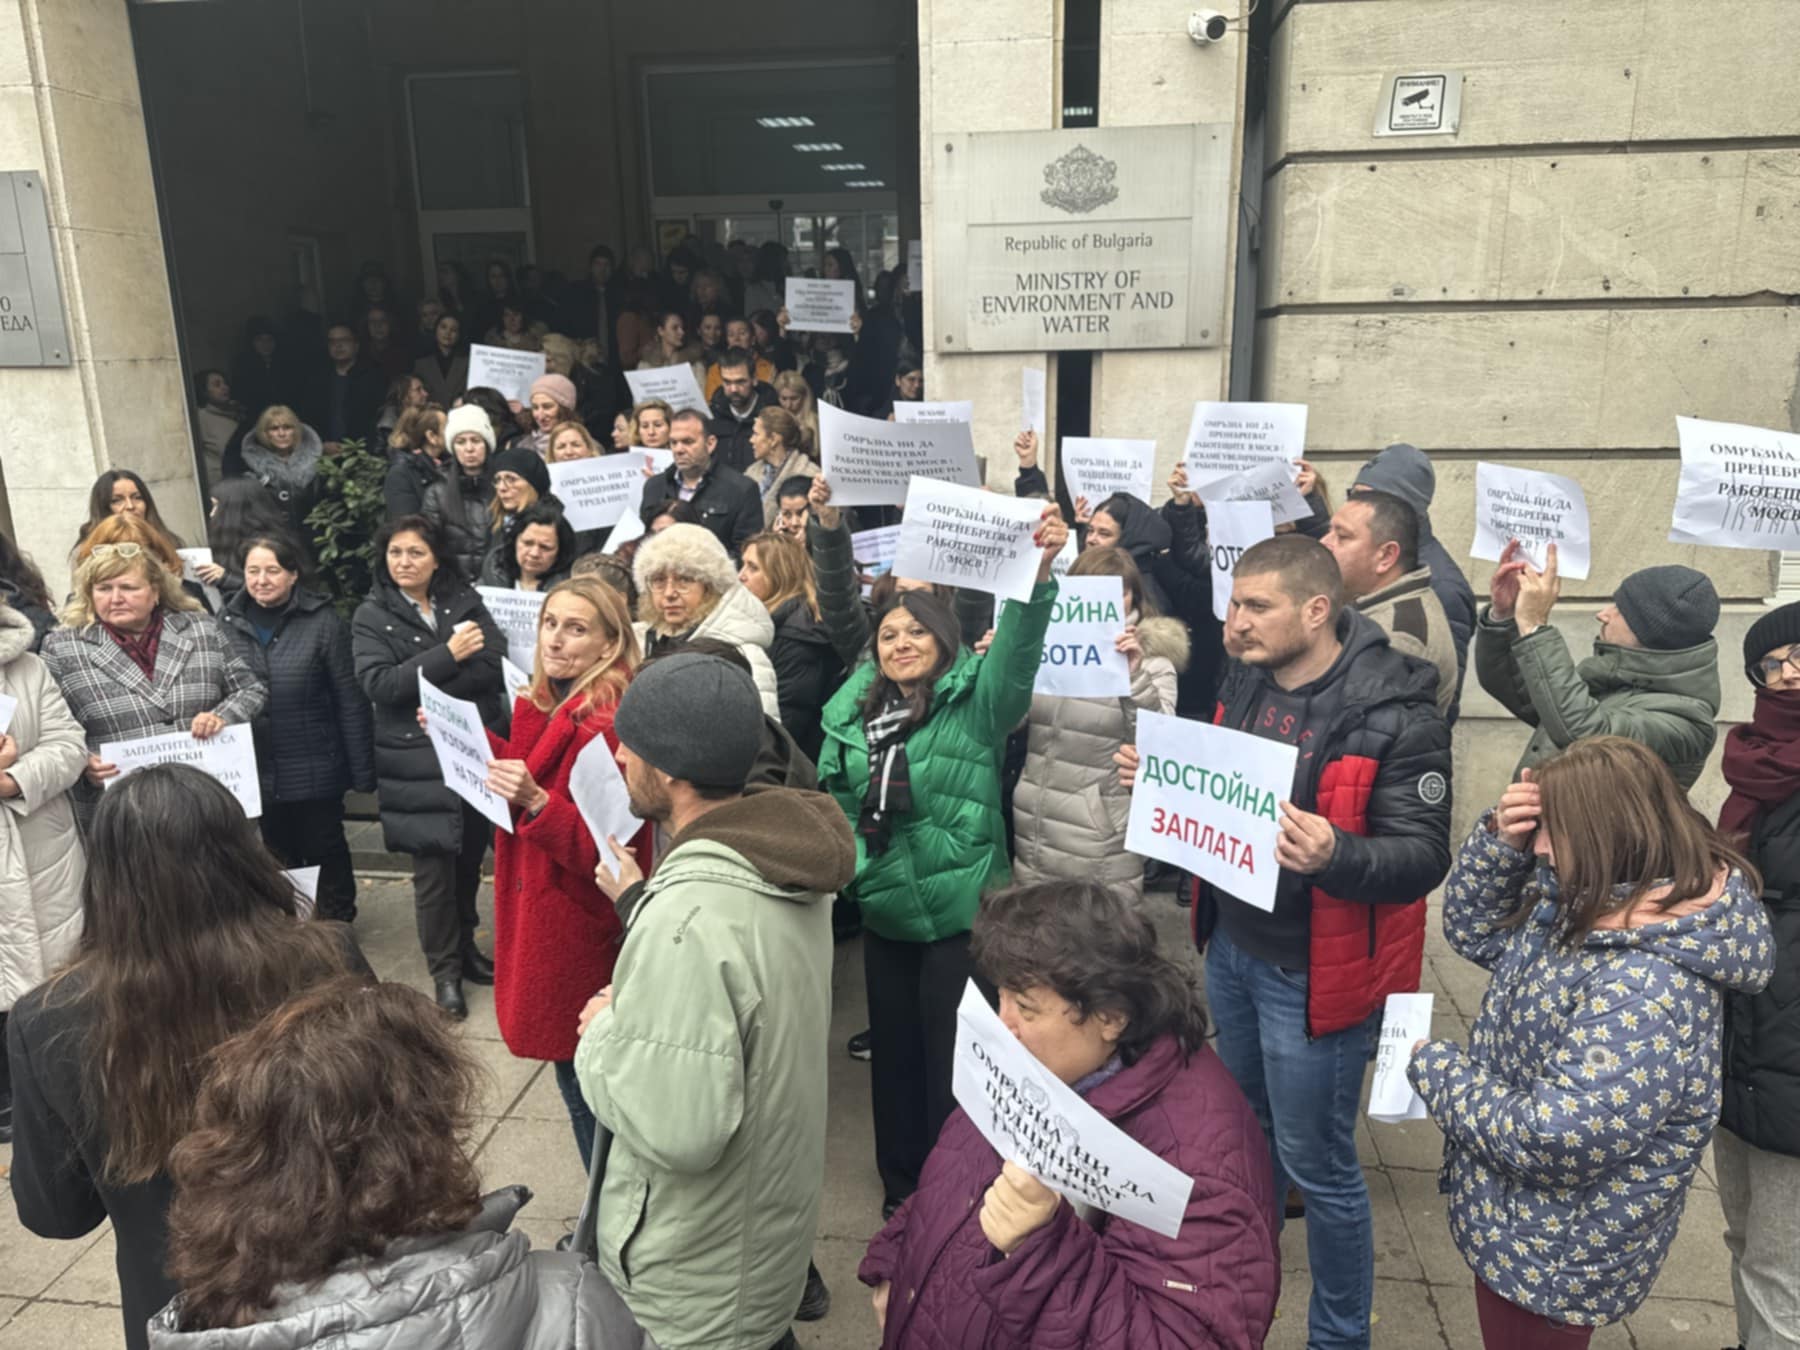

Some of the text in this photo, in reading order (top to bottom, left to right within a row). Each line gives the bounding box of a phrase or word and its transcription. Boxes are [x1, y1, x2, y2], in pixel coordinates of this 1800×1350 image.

[1005, 233, 1153, 254] Republic of Bulgaria
[1016, 269, 1141, 291] MINISTRY OF
[982, 291, 1174, 313] ENVIRONMENT AND
[0, 314, 33, 331] ЕДА
[1042, 314, 1110, 334] WATER
[1261, 422, 1275, 430] ДА
[843, 433, 935, 448] ОМРЪЗНА НИ ДА
[1710, 443, 1795, 461] ОМРЪЗНА
[1725, 461, 1800, 478] ПРЕНЕБР
[1487, 488, 1530, 505] ОМРЪЗНА
[1556, 499, 1572, 510] ДА
[926, 502, 986, 524] ОМРЪЗНА
[1013, 519, 1031, 531] ДА
[932, 519, 1019, 543] ПРЕНЕБРЕГВАТ
[1040, 644, 1102, 666] БОТА
[122, 738, 194, 758] ЗАПЛАТИТЕ
[220, 733, 236, 745] СА
[1142, 754, 1277, 822] ДОСТОЙНА
[1151, 807, 1255, 874] ЗАПЛАТА
[971, 1041, 1156, 1204] ОМРЪЗНА НИ ДА
[985, 1080, 1126, 1201] ПОДЦЕНЯВАТ
